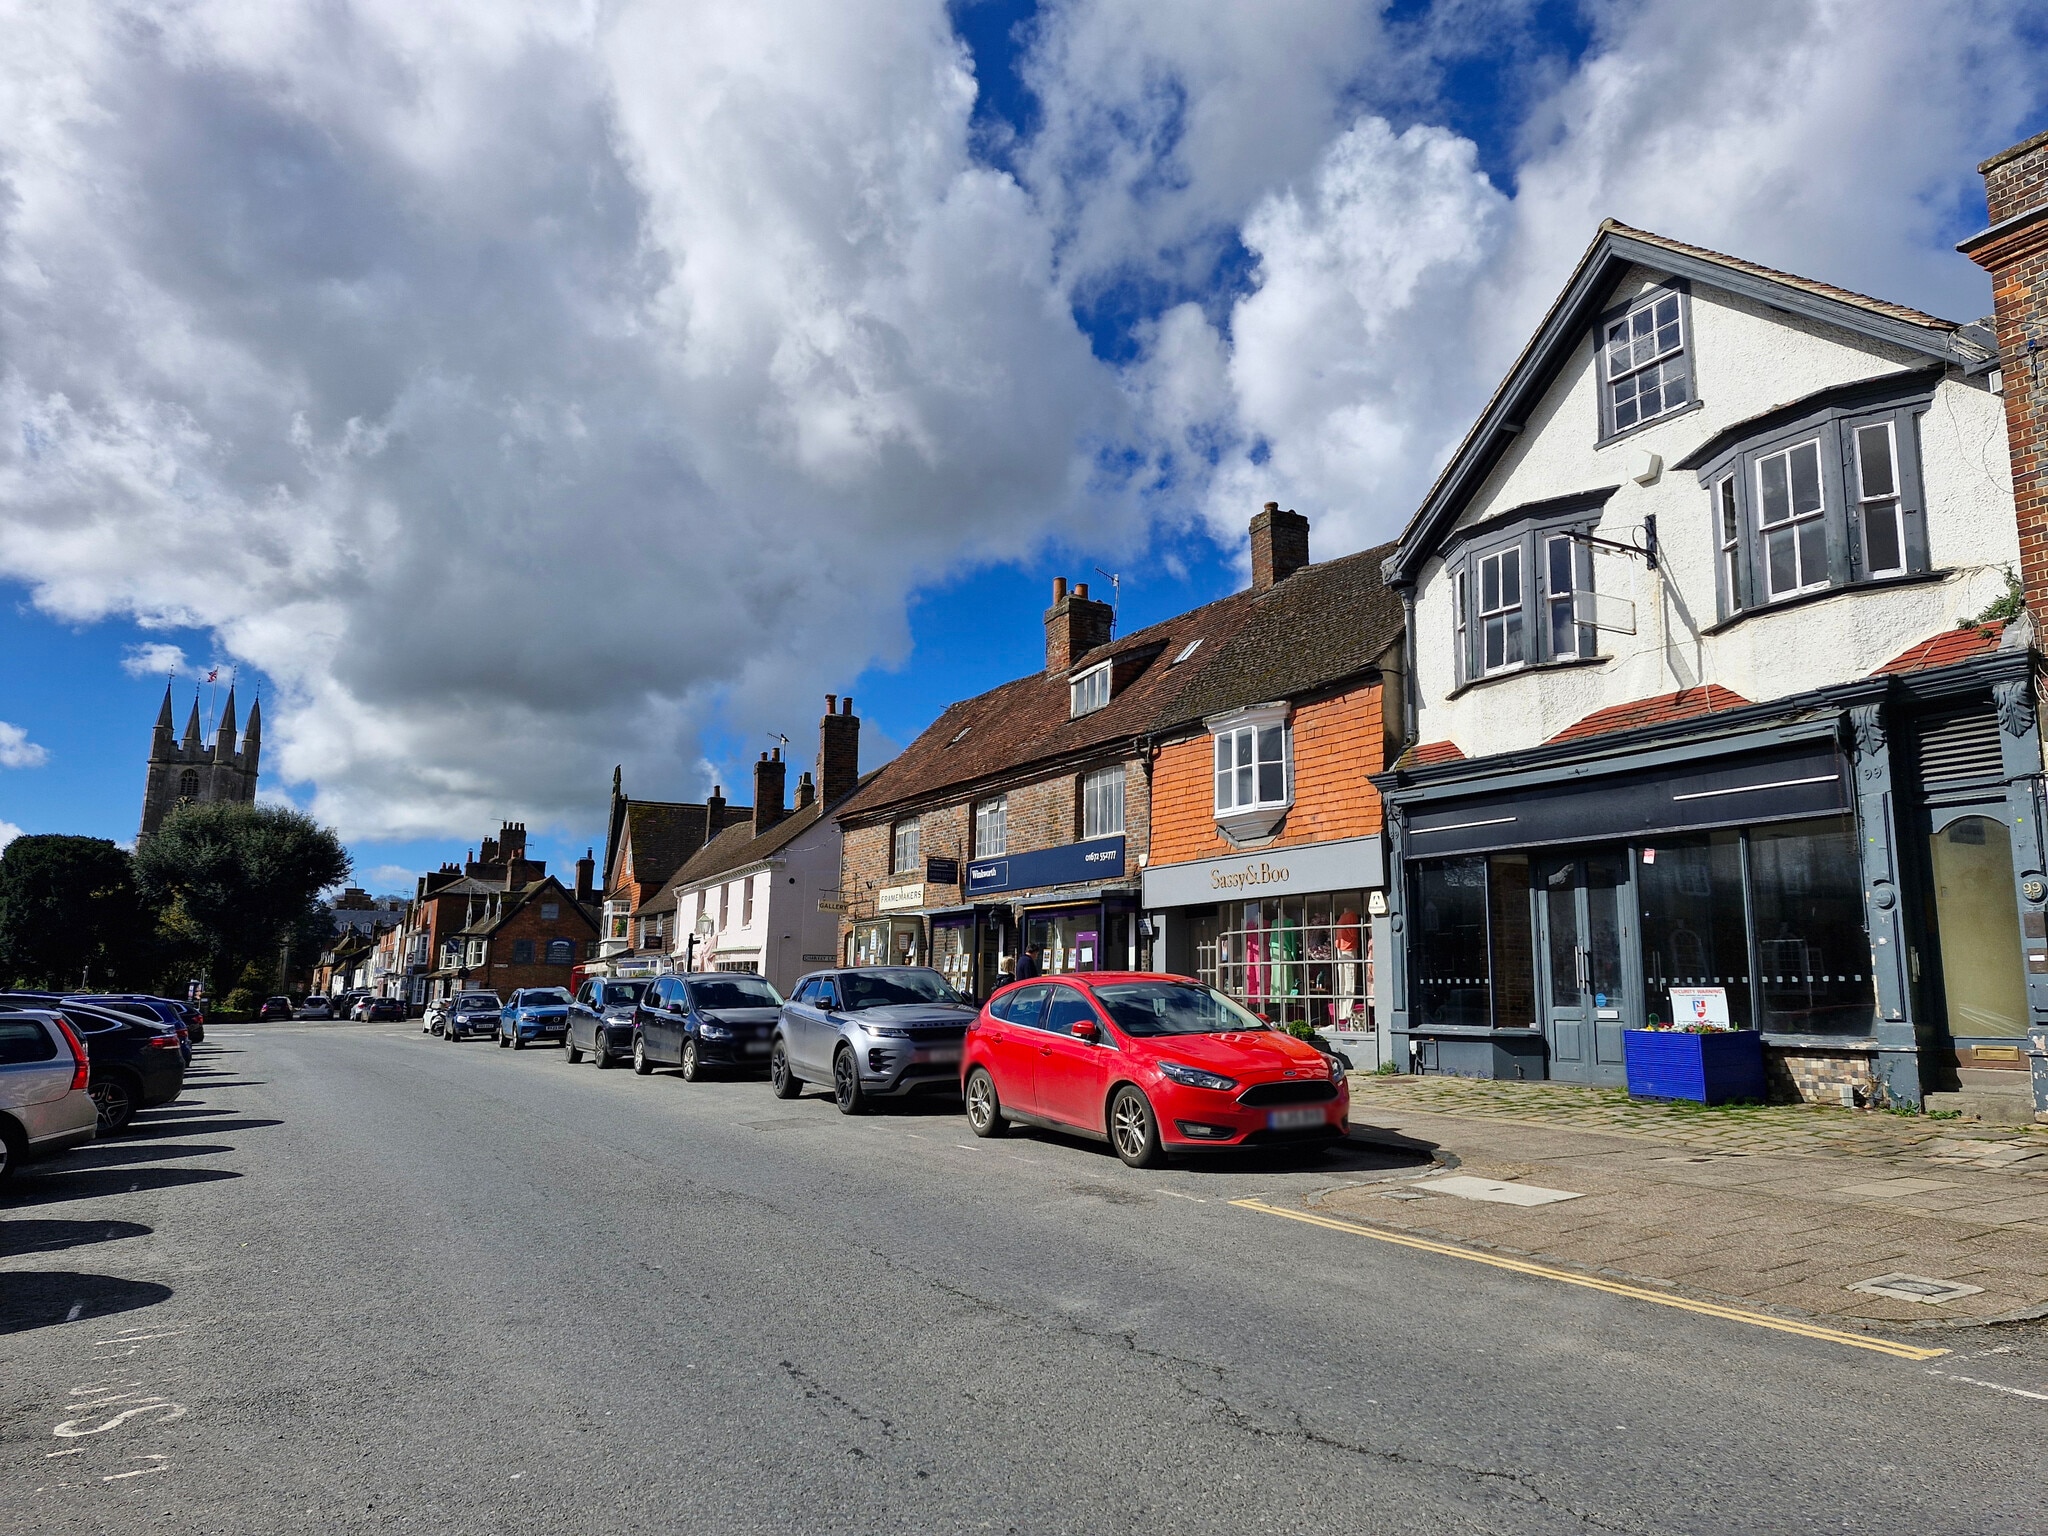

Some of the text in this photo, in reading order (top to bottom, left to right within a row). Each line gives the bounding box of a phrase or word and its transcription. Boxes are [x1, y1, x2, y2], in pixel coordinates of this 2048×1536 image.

[1864, 767, 1882, 780] 99
[972, 866, 997, 879] Winkworth
[2022, 881, 2041, 895] 99
[881, 890, 922, 904] FRAMEMAKERS
[819, 902, 848, 911] GALLERY
